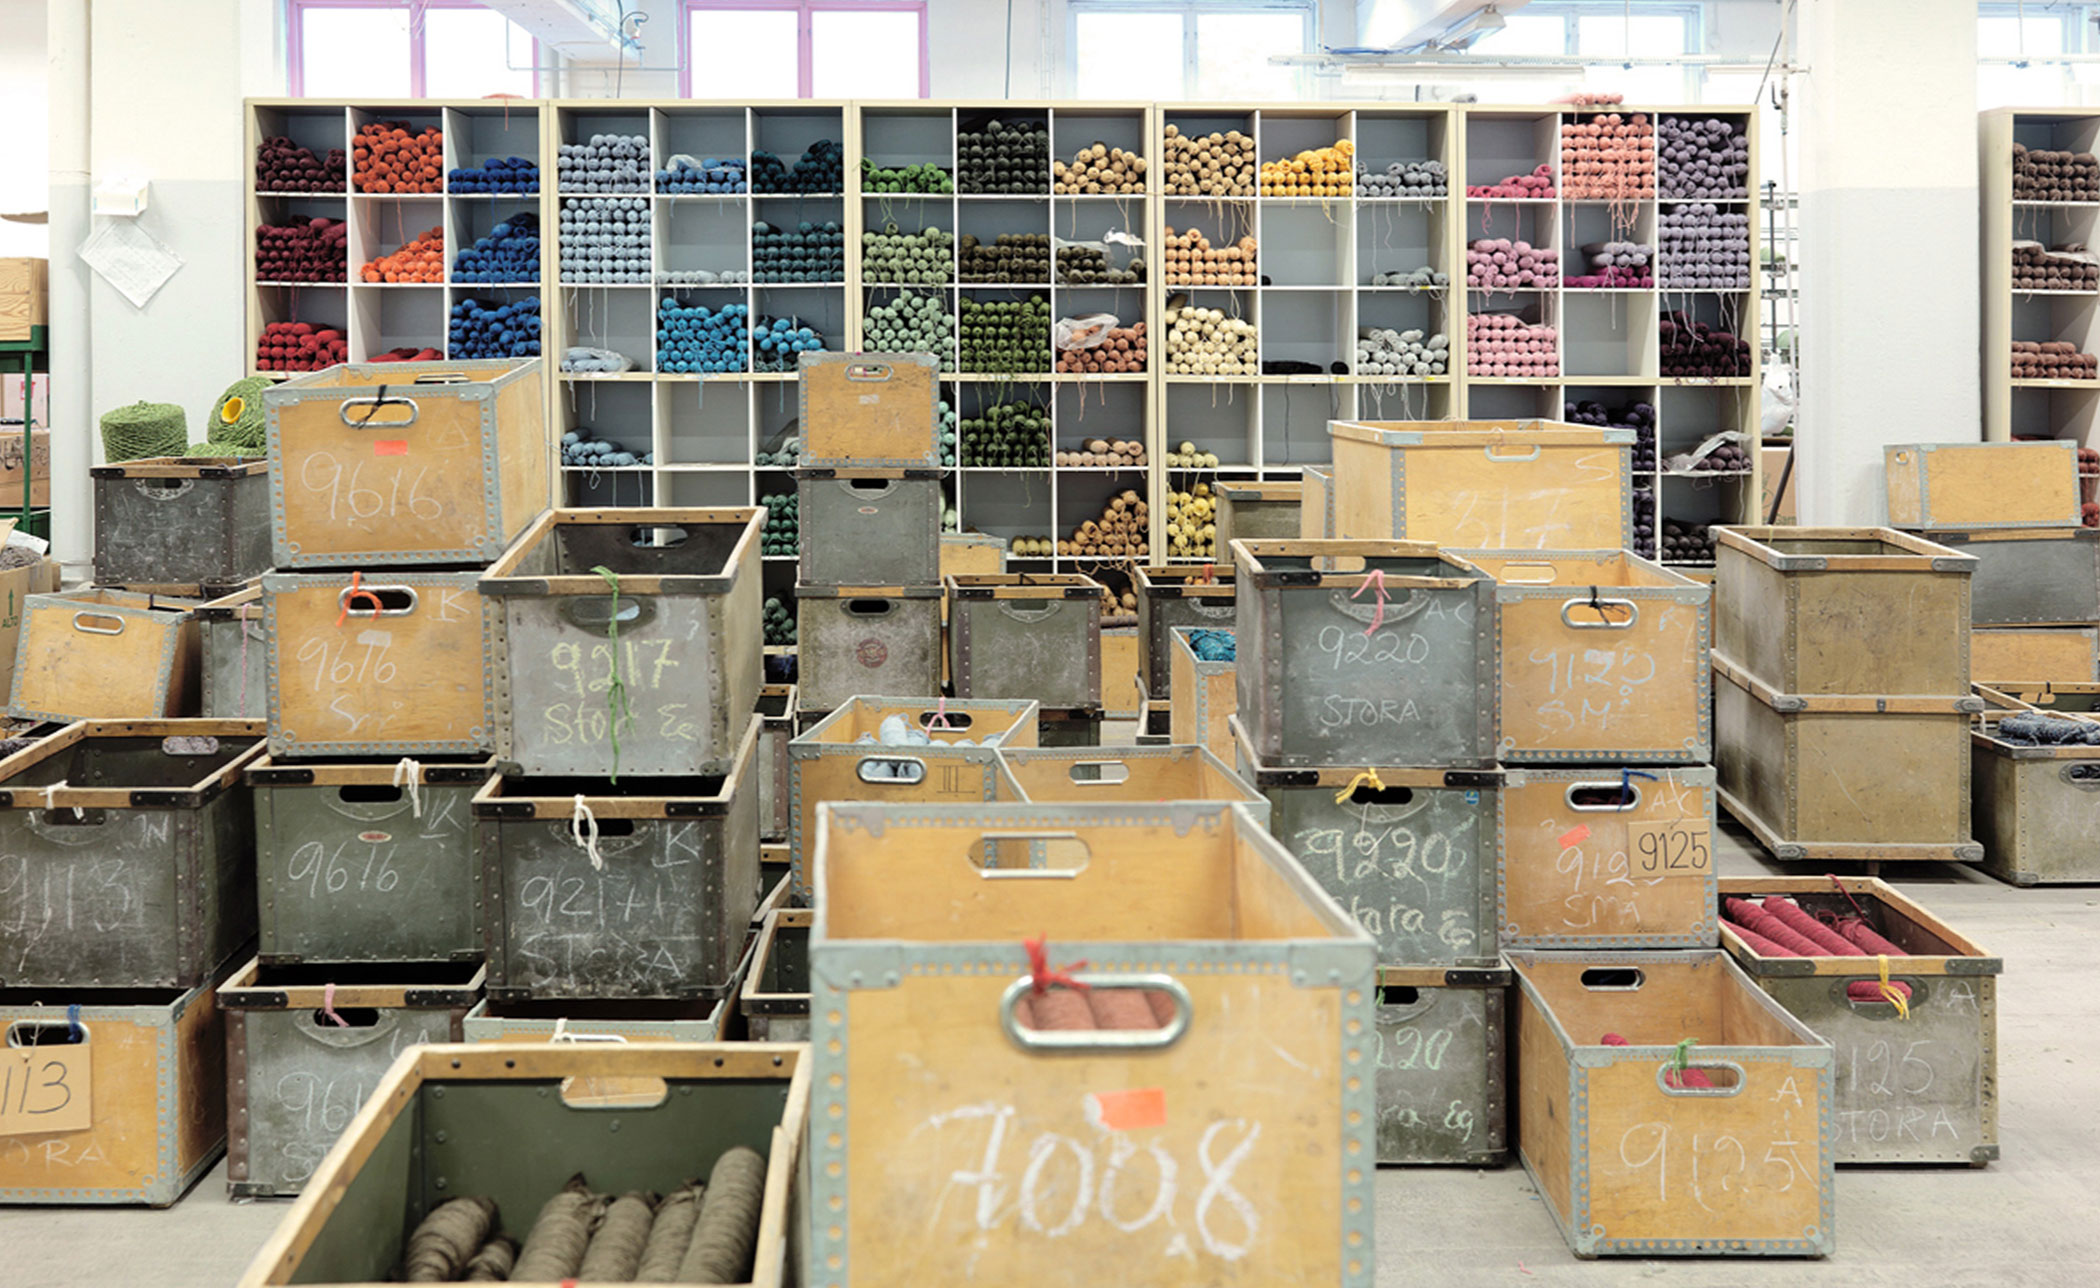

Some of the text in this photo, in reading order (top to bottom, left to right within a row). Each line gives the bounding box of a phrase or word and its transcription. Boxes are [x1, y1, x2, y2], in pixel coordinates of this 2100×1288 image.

[302, 451, 442, 520] 9616
[297, 636, 396, 692] 9616
[552, 639, 679, 698] 9217
[1318, 625, 1430, 670] 9220
[1320, 694, 1420, 727] STORA
[288, 841, 399, 898] 9616
[1304, 827, 1451, 882] 9220
[1639, 831, 1708, 871] 9125
